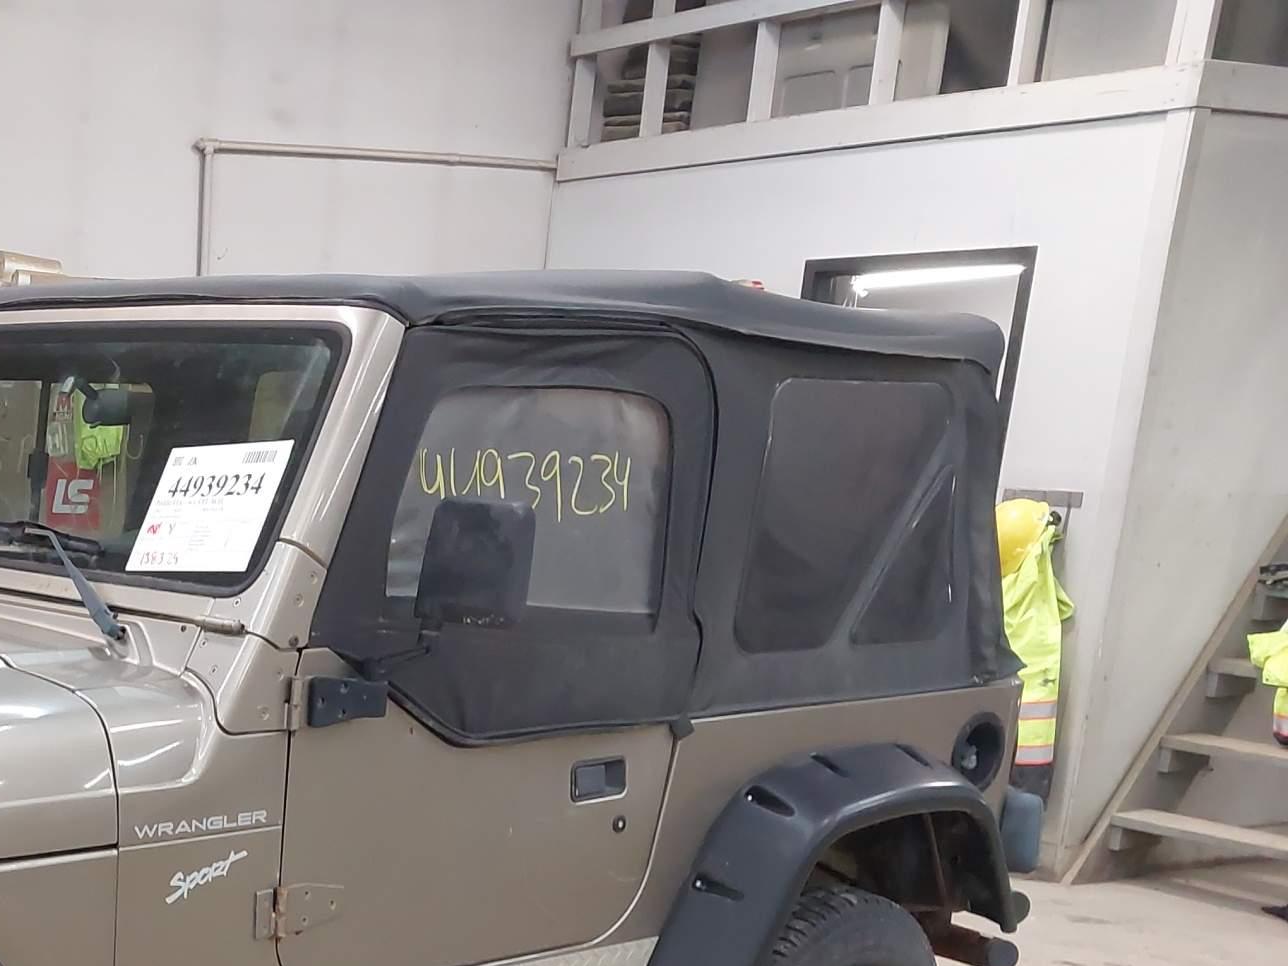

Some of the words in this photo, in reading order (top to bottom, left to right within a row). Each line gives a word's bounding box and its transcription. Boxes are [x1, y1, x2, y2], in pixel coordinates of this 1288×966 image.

[52, 478, 94, 514] LS
[168, 472, 266, 498] 44939234
[134, 810, 268, 839] WRANGLER
[165, 850, 248, 904] Sport
